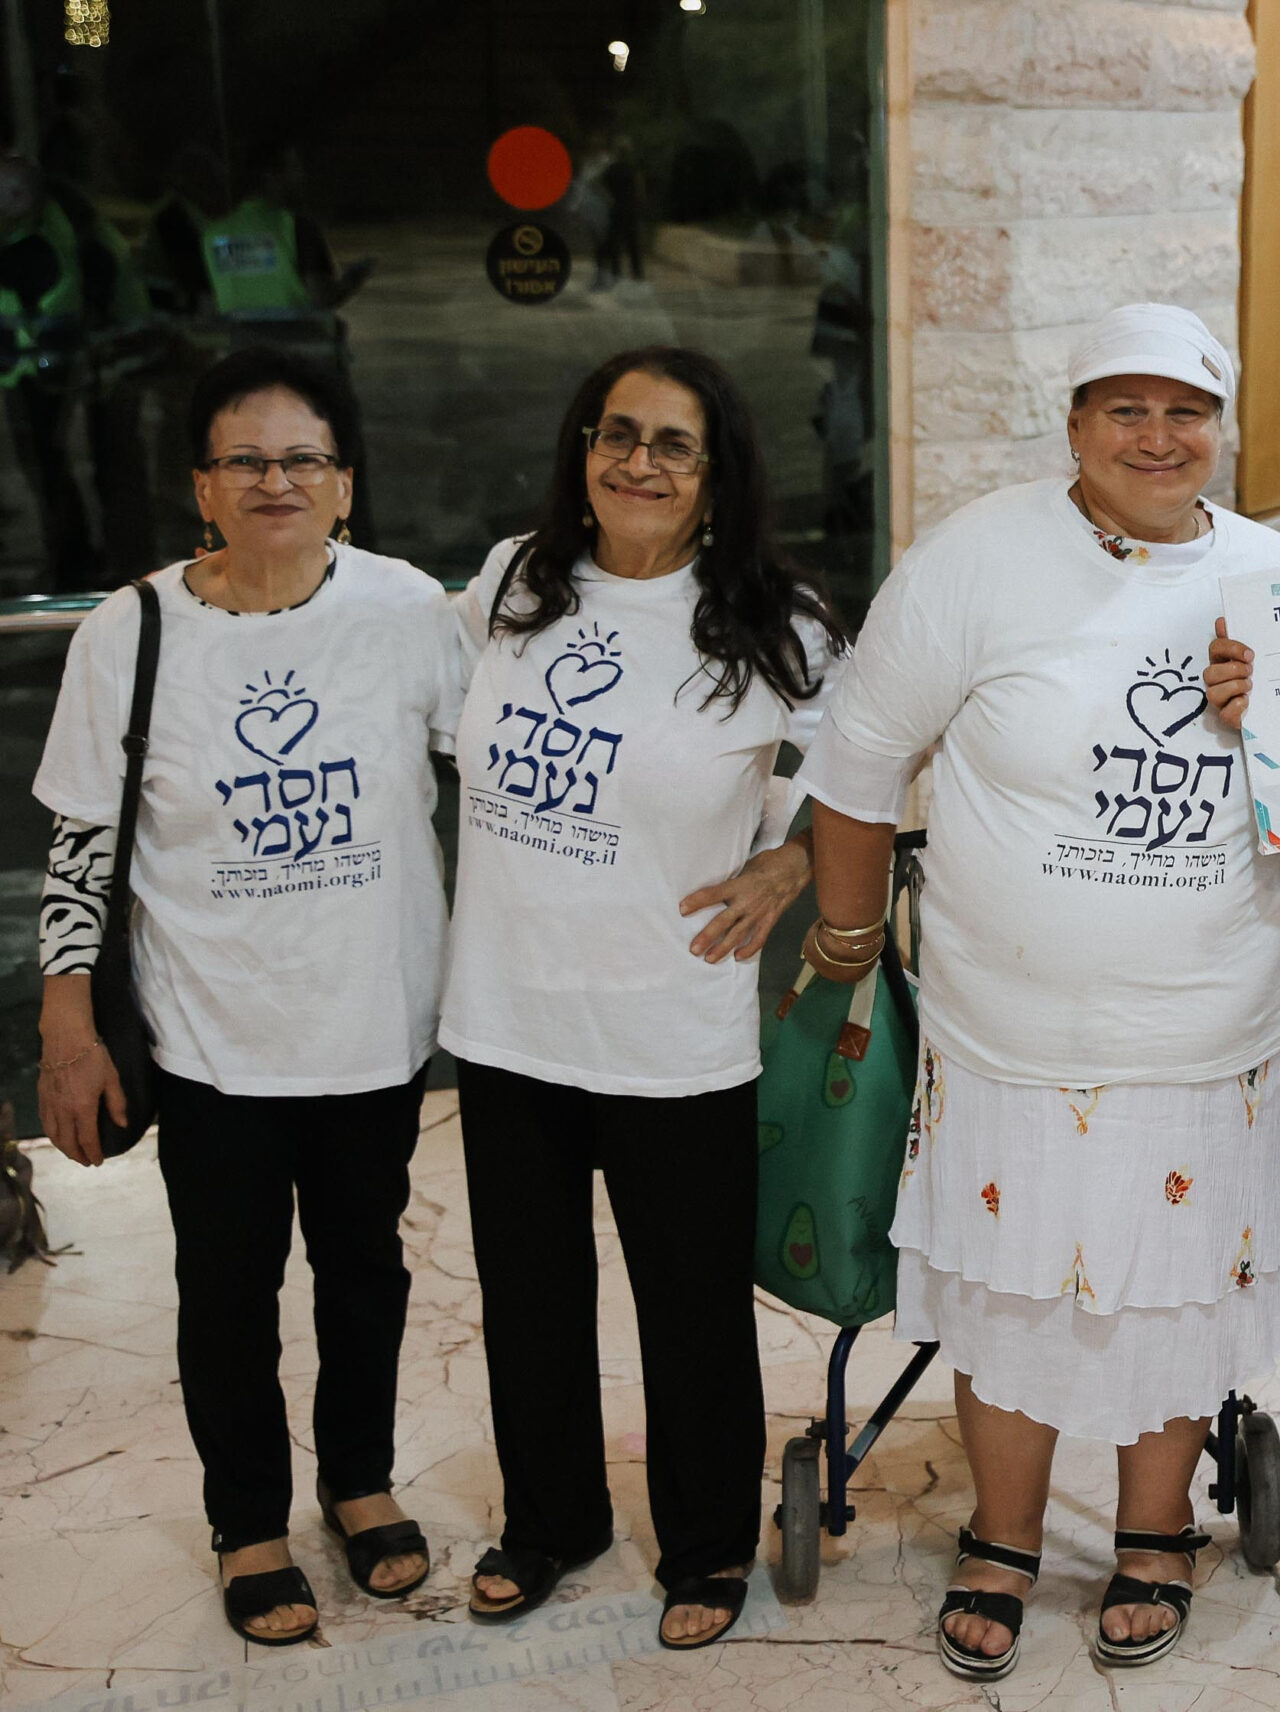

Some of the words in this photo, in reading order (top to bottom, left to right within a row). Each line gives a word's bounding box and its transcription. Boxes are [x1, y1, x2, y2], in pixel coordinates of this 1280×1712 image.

[496, 703, 623, 775] חסדי
[215, 757, 361, 813] חסדי
[487, 743, 599, 814] נעמי
[1092, 743, 1234, 798] חסדי
[233, 803, 353, 862] נעמי
[571, 824, 620, 846] מישהו
[1094, 790, 1215, 852] נעמי
[211, 865, 381, 899] www.naomi.org.il
[334, 849, 382, 868] מישהו
[1042, 862, 1225, 892] www.naomi.org.il
[1184, 852, 1226, 868] מישהו
